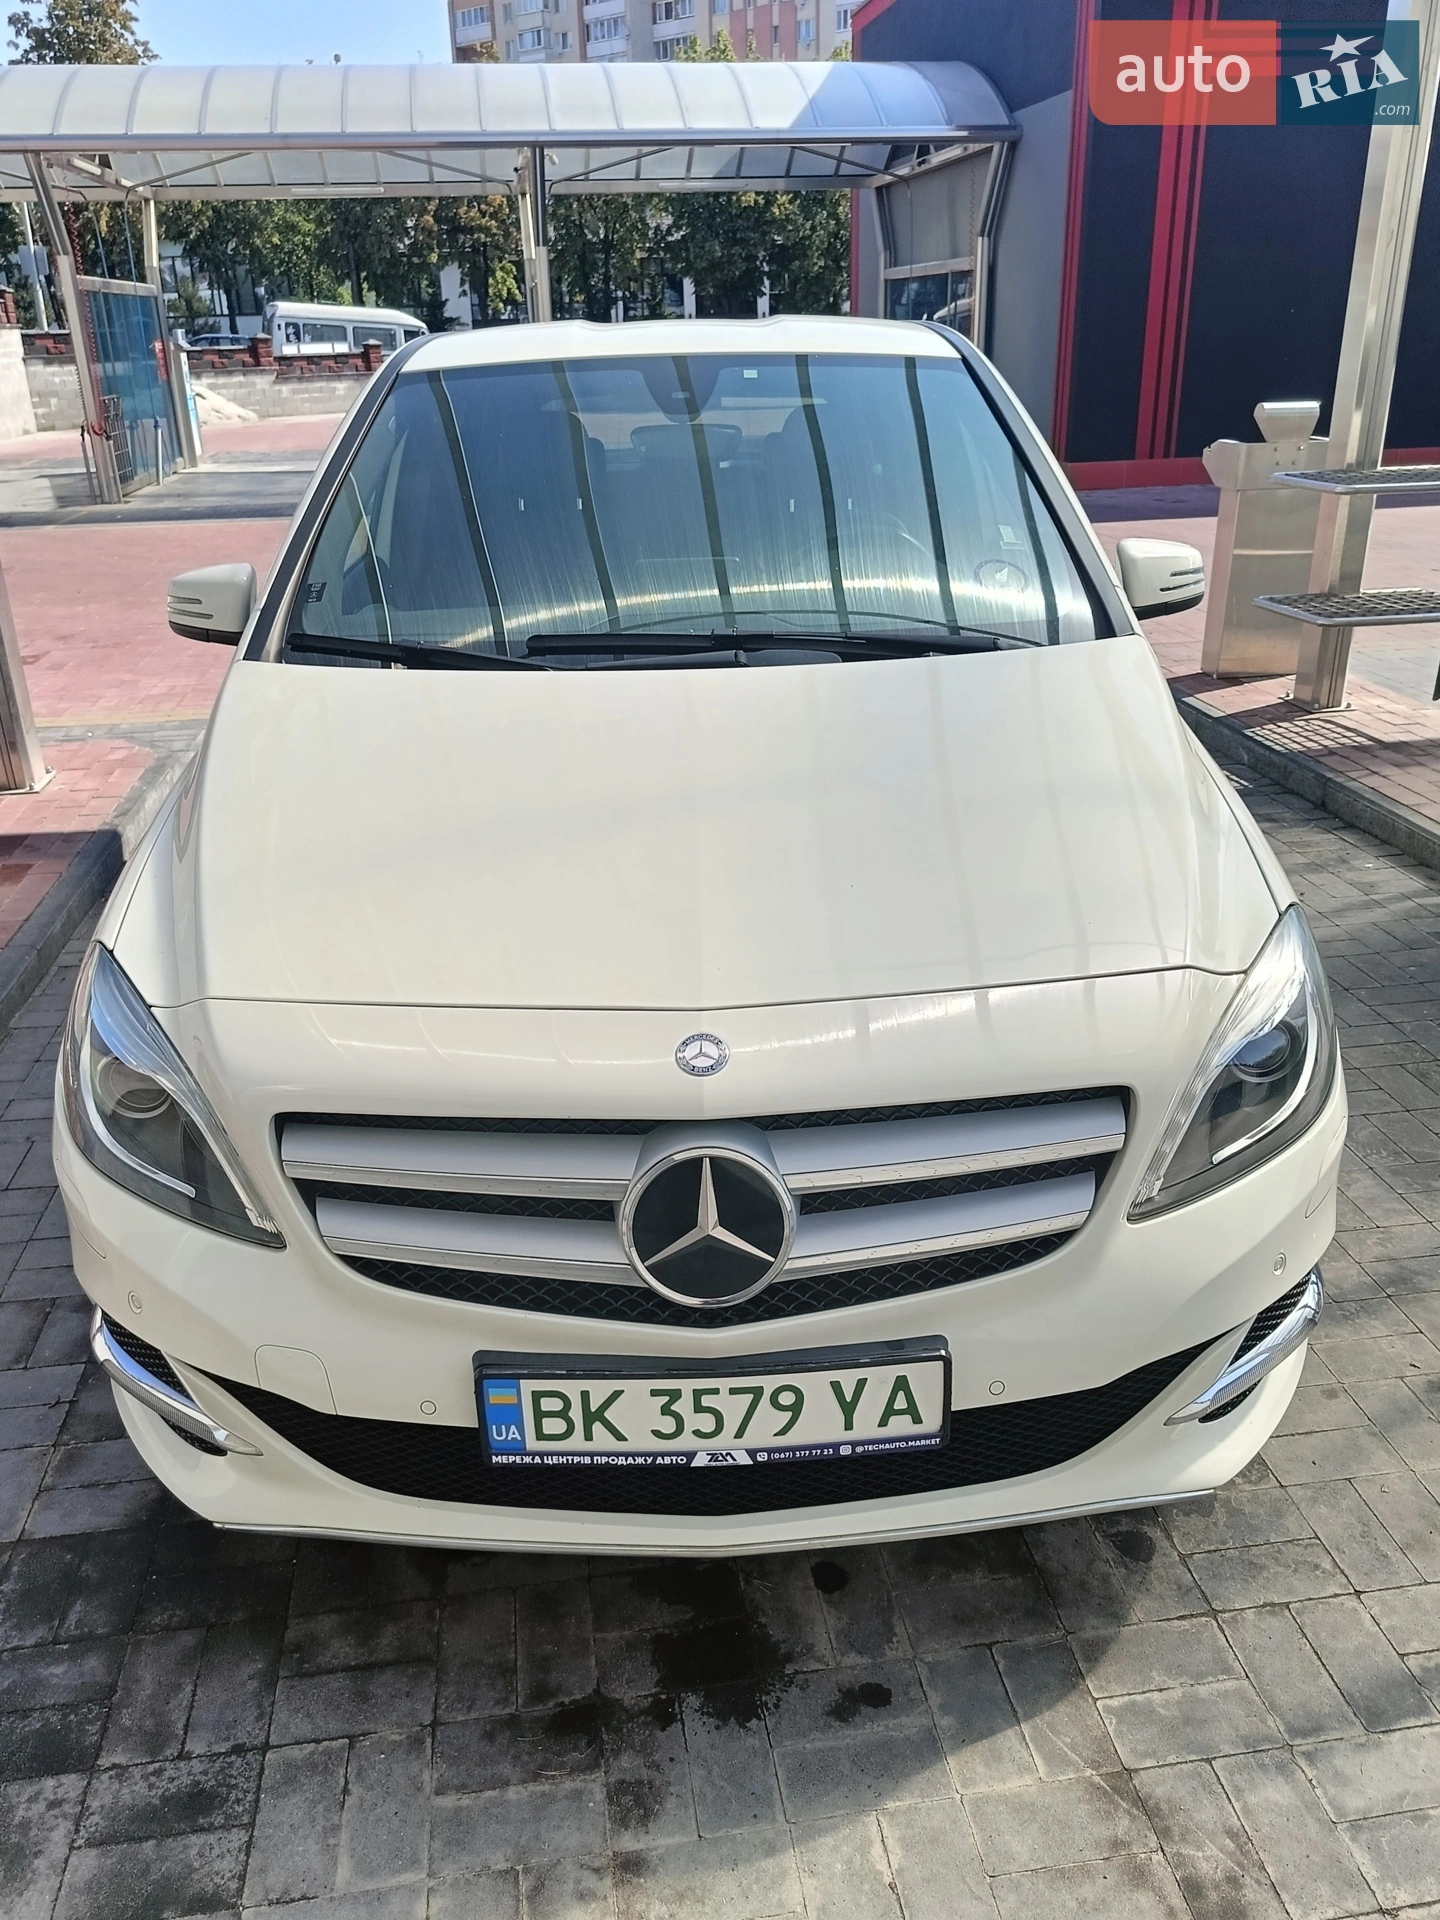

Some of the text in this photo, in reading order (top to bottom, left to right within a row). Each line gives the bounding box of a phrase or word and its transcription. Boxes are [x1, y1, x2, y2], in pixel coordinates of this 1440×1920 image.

[531, 1374, 924, 1442] BK 3579 YA
[491, 1424, 522, 1441] UA
[855, 1438, 941, 1453] @TECHAUTO.MARKET
[491, 1455, 687, 1465] МЕРЕЖА ЦЕНТРІВ ПРОДАЖУ АВТО
[770, 1451, 793, 1460] (067)
[795, 1450, 809, 1458] 377
